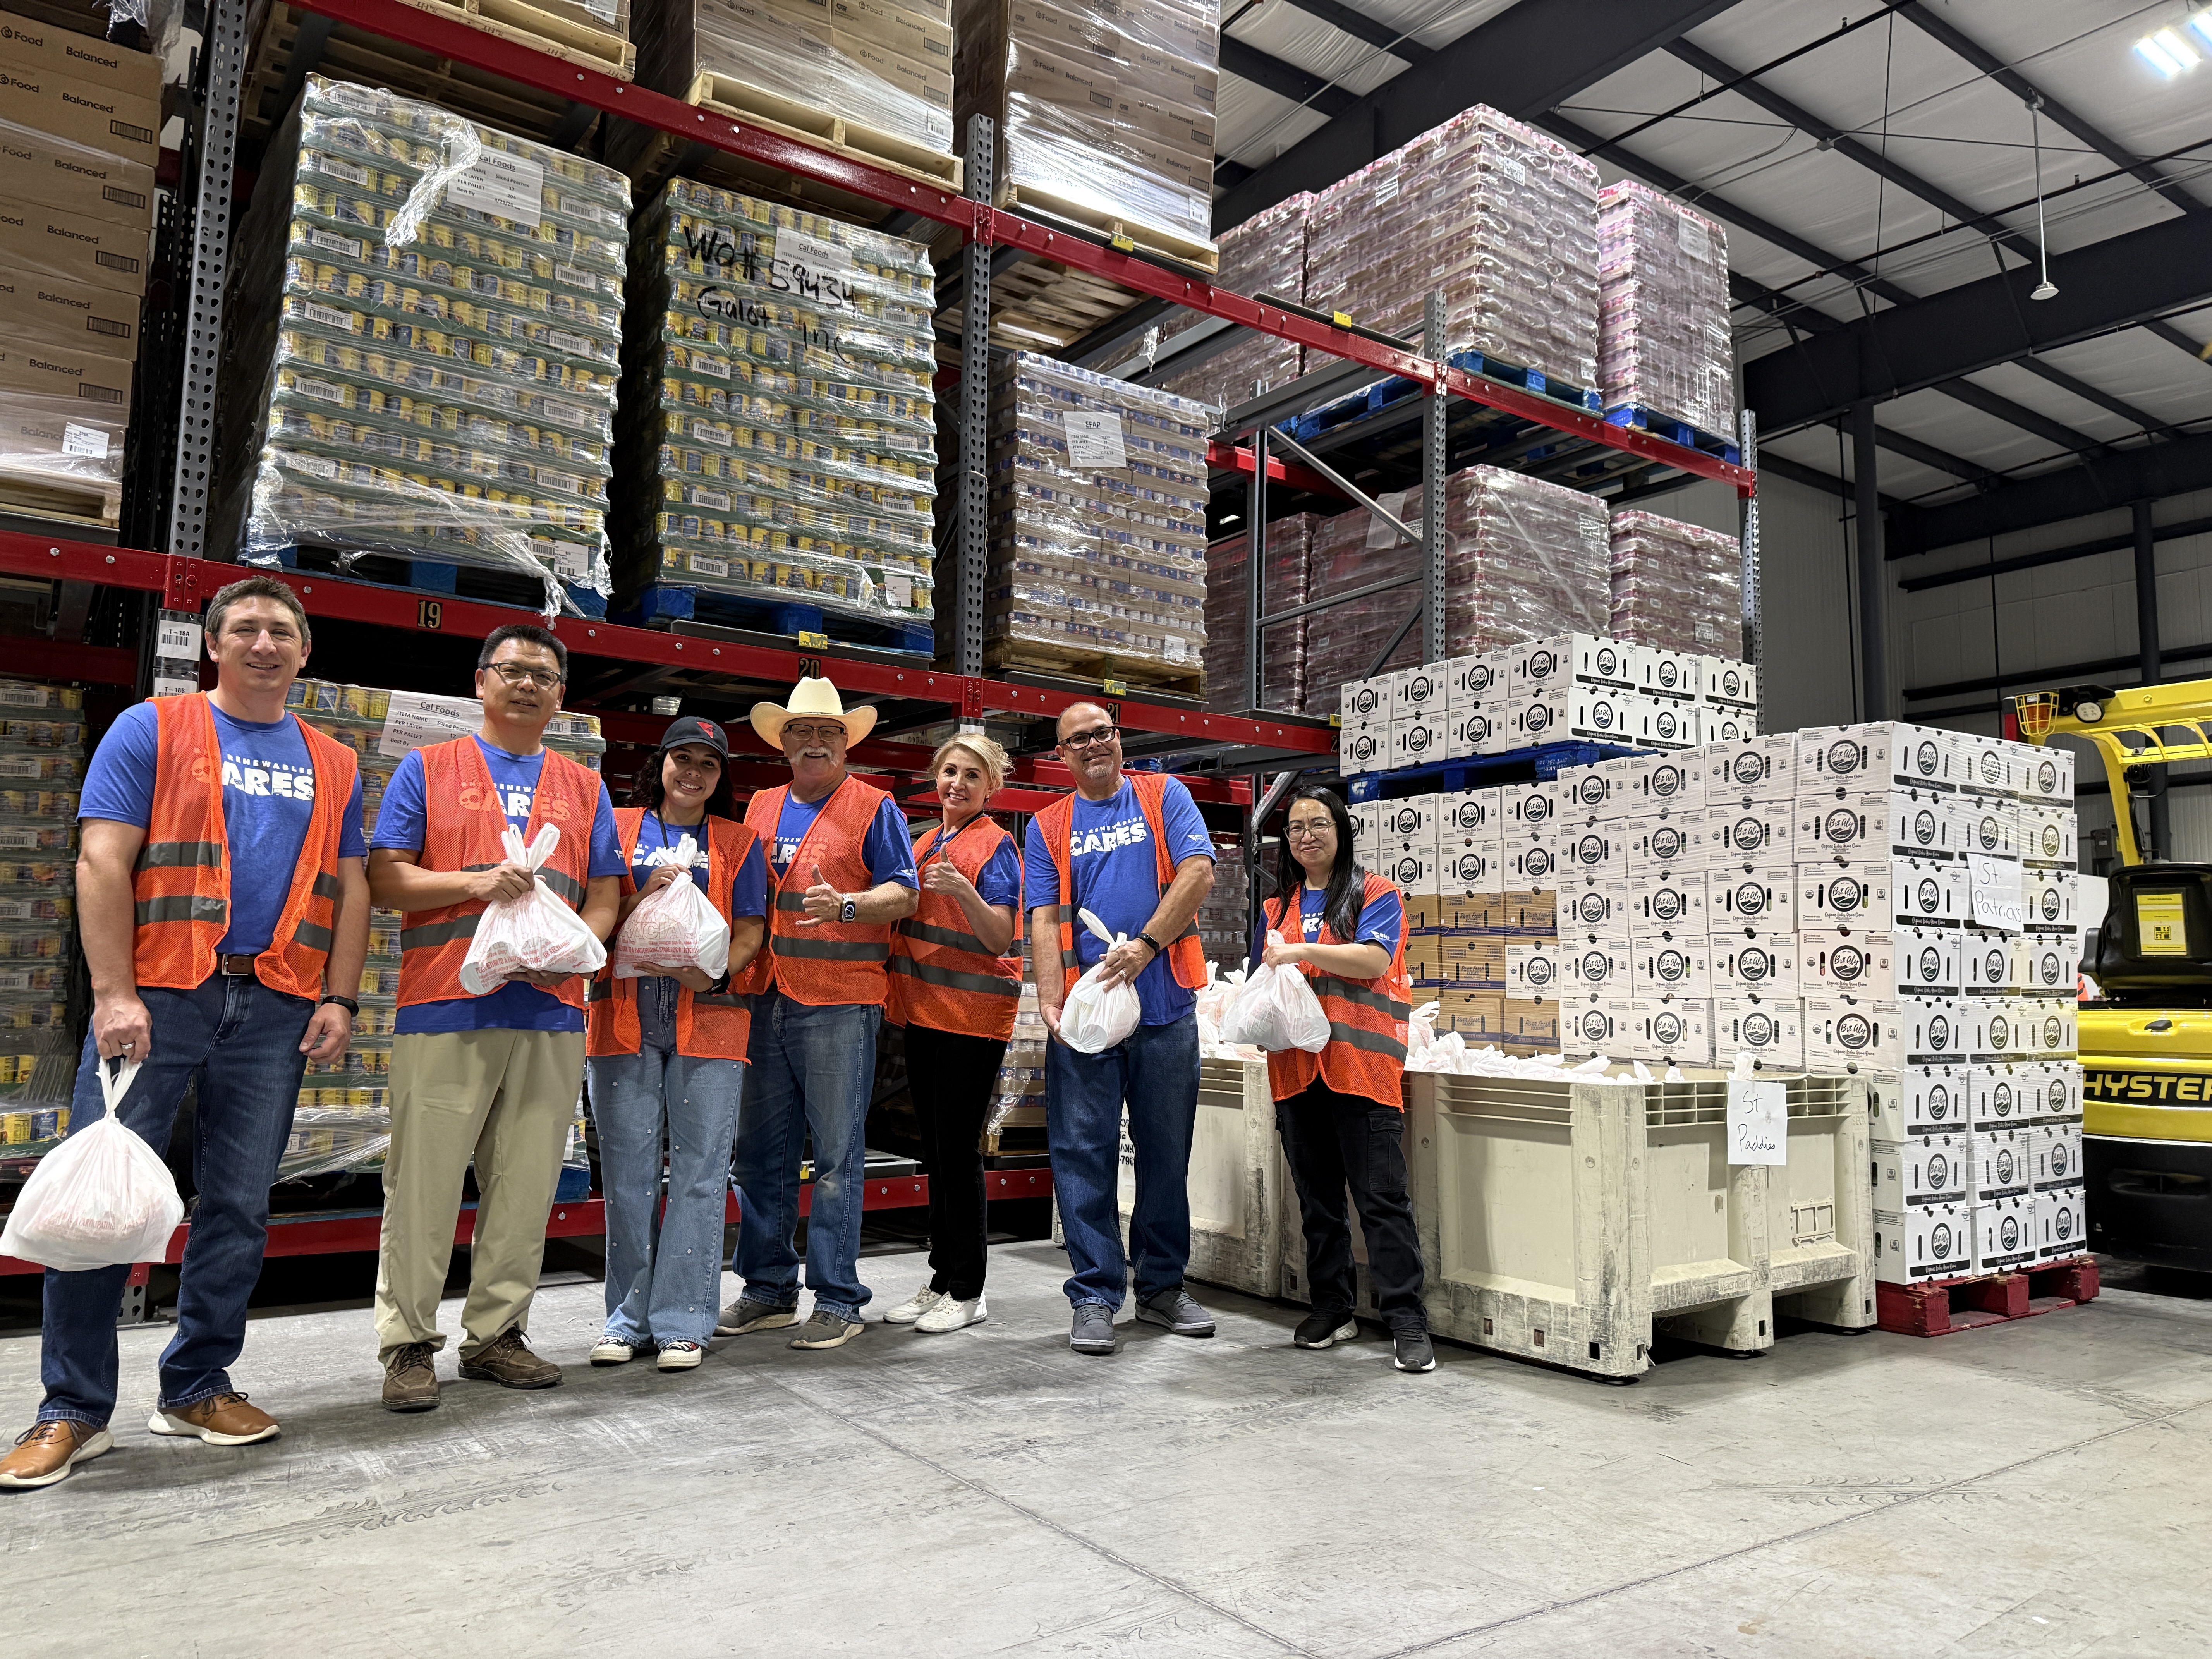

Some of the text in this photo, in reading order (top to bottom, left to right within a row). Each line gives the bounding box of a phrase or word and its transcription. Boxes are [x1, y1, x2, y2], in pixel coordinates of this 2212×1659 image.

[866, 5, 926, 33] Food Balanced
[14, 31, 43, 47] Food
[66, 46, 118, 68] Balanced
[867, 53, 927, 81] Food Balanced
[1039, 62, 1092, 87] Food Balanced
[1171, 65, 1196, 80] Balanced
[11, 78, 39, 93] Food
[62, 93, 113, 113] Balanced
[2, 146, 31, 160] Food
[55, 159, 106, 179] Balanced
[493, 158, 516, 171] Foods
[1166, 158, 1191, 172] Balanced
[468, 173, 483, 182] LAYER
[468, 182, 485, 190] PALLET
[496, 174, 529, 188] Sliced Peaches
[47, 225, 99, 244] Balanced
[811, 247, 829, 258] Foods
[38, 291, 91, 309] Balanced
[803, 322, 851, 364] Inc
[30, 359, 82, 376] Balanced
[418, 600, 441, 629] 19
[799, 658, 821, 679] 20
[421, 702, 460, 717] Cal Foods
[1108, 703, 1119, 724] 21
[404, 731, 423, 739] PALLET
[437, 721, 473, 734] Sliced Peaches
[227, 754, 313, 775] RENEWABLES
[1089, 816, 1143, 833] RENEWABLES
[1070, 822, 1147, 856] CARES
[1975, 890, 2022, 922] Patrick's
[2083, 1073, 2212, 1101] HYSTE
[1743, 1091, 1764, 1114] St
[1737, 1123, 1776, 1152] Paddies
